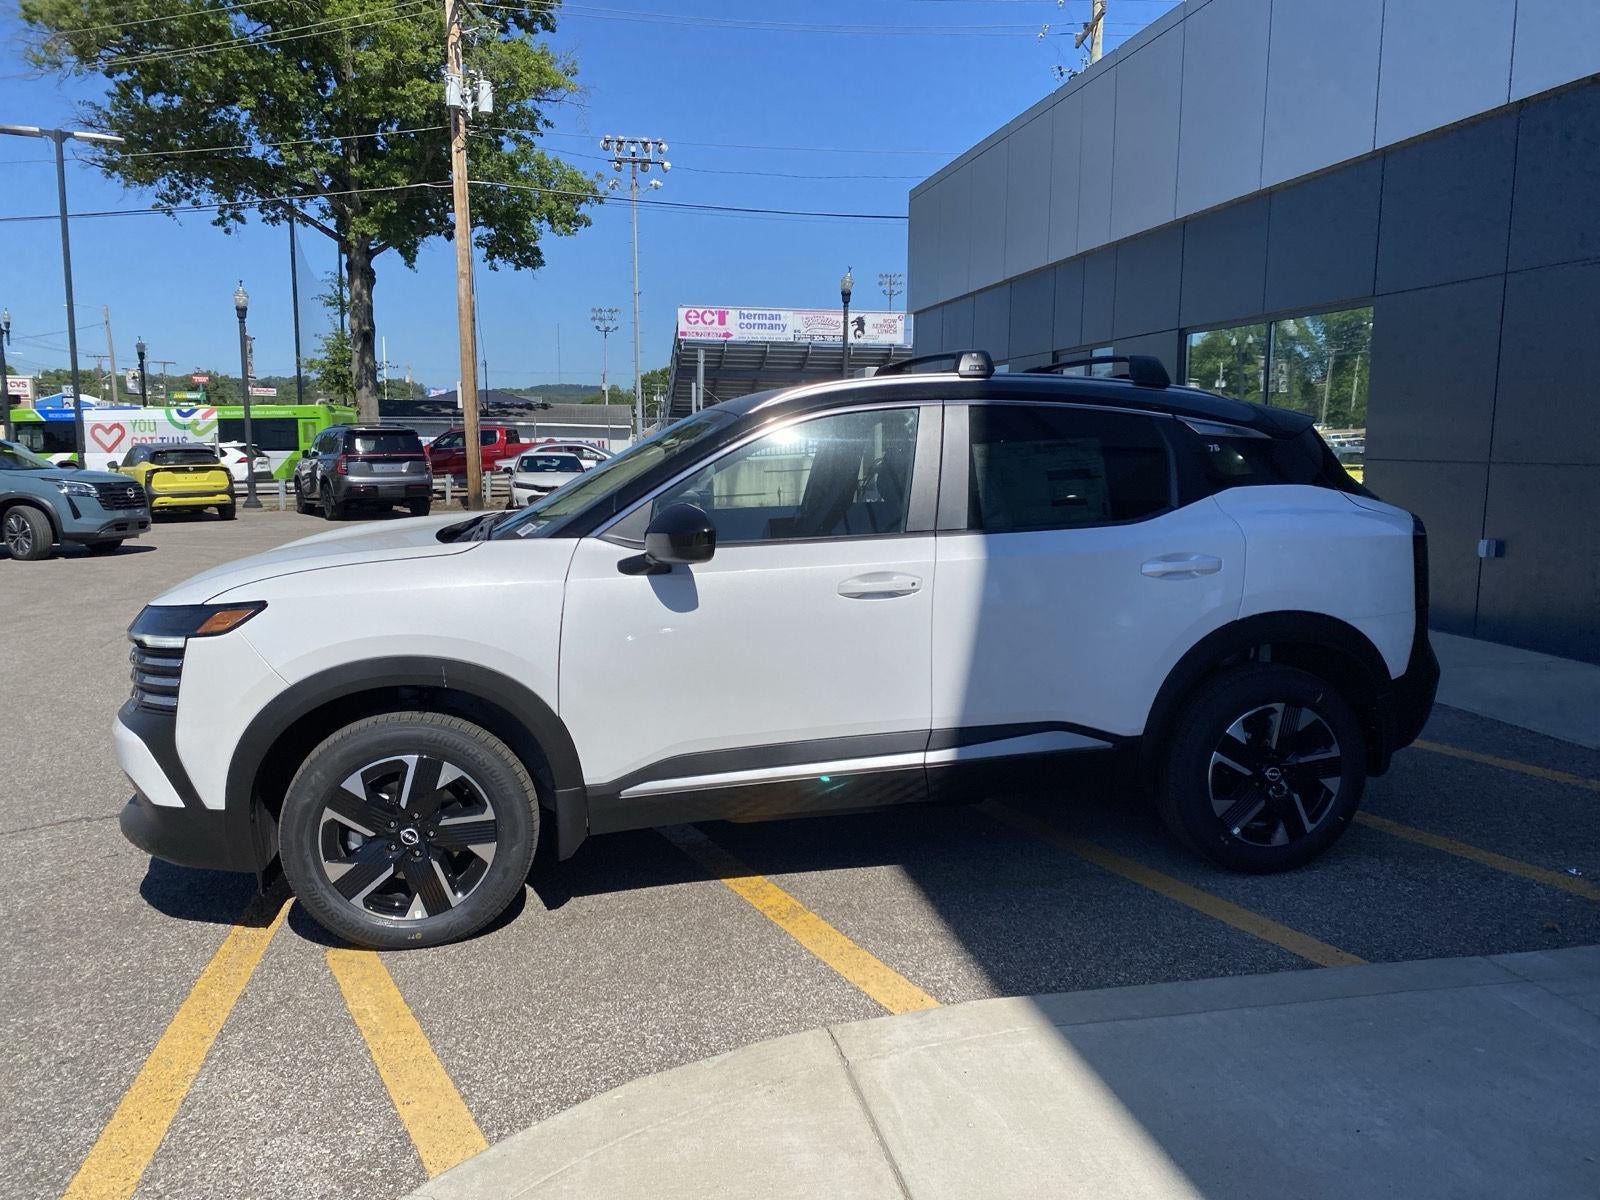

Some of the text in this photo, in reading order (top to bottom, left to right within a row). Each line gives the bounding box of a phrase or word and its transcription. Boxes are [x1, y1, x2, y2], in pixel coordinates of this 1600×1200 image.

[739, 310, 782, 321] herman
[739, 321, 788, 333] cormany
[130, 419, 156, 432] YOU
